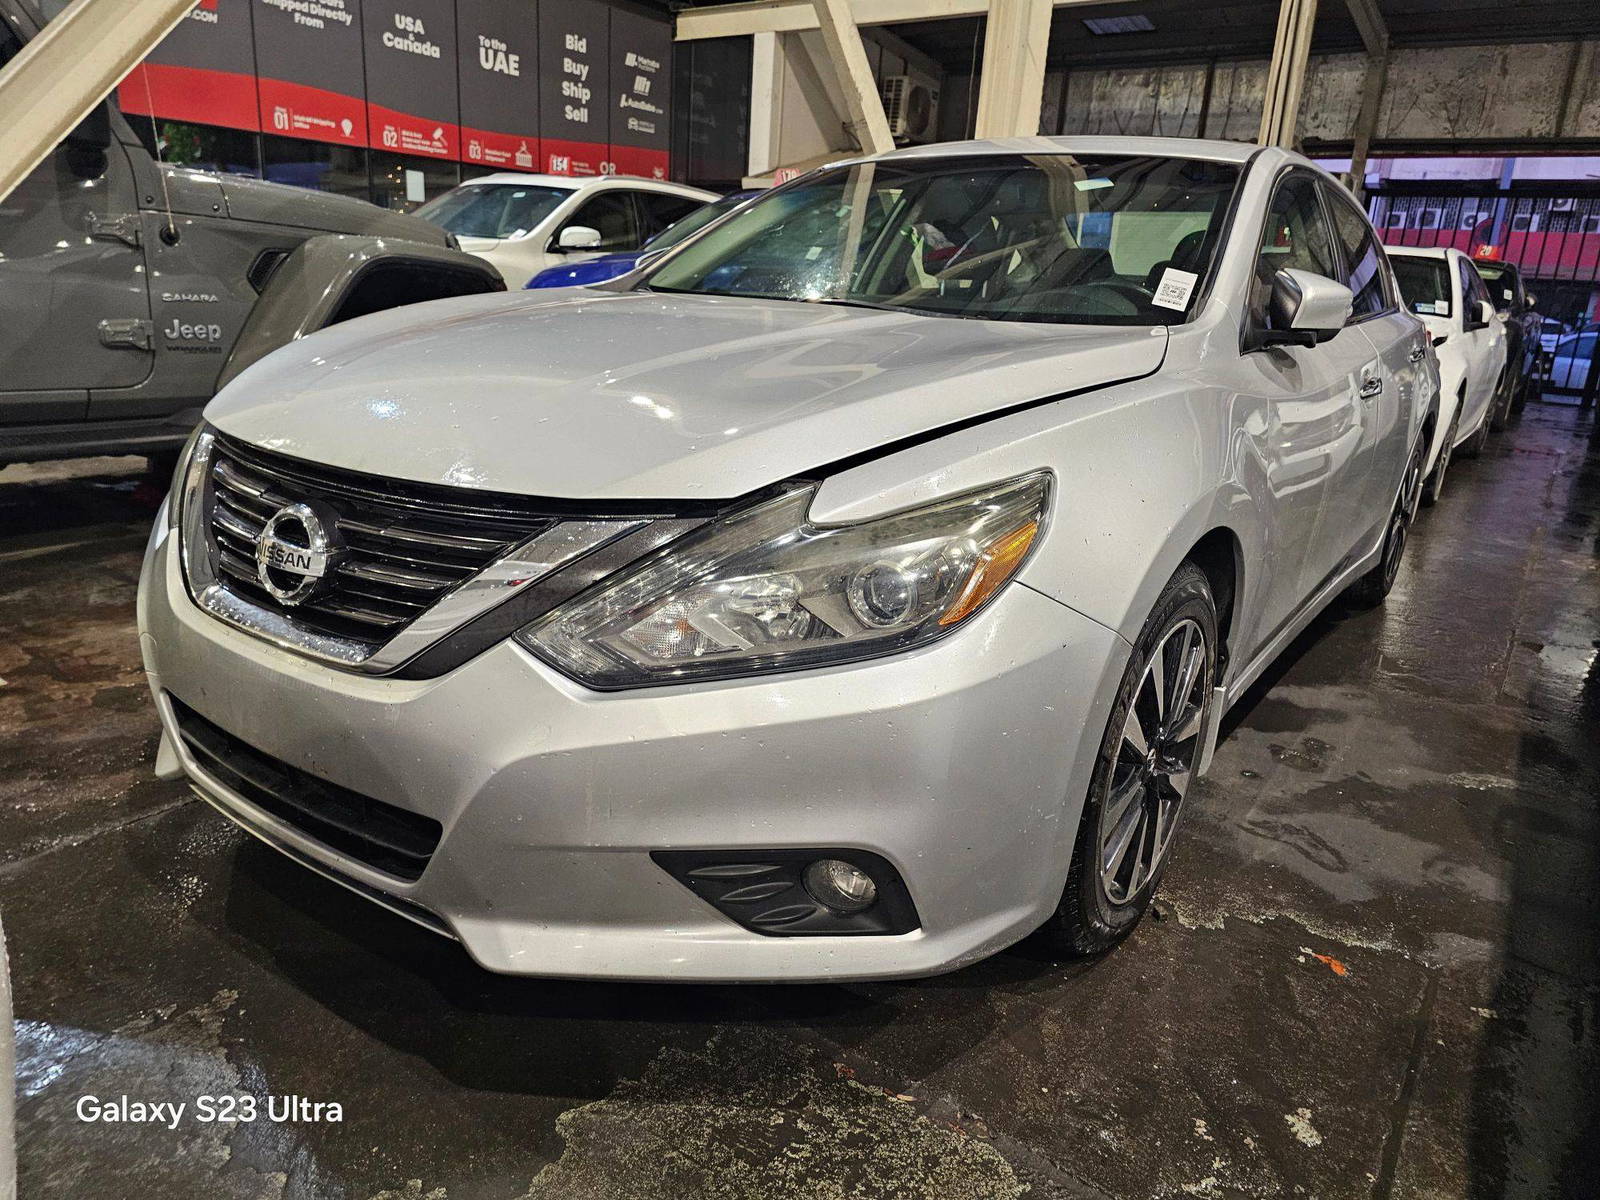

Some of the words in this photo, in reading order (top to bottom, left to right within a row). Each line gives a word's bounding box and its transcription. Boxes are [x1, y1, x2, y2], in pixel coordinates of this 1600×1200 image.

[294, 12, 324, 29] From
[309, 3, 352, 26] Directly
[395, 13, 425, 35] USA
[383, 31, 440, 58] Canada
[478, 34, 491, 48] To
[491, 39, 507, 52] the
[565, 34, 587, 53] Bid
[479, 46, 520, 77] UAE
[563, 57, 589, 81] Buy
[562, 81, 591, 105] Ship
[274, 111, 289, 130] 01
[565, 105, 589, 123] Sell
[383, 130, 398, 148] 02
[600, 161, 616, 176] OR
[1480, 245, 1493, 256] 20
[161, 293, 219, 302] SAHARA
[164, 318, 222, 342] Jeep
[260, 536, 312, 570] NISSAN
